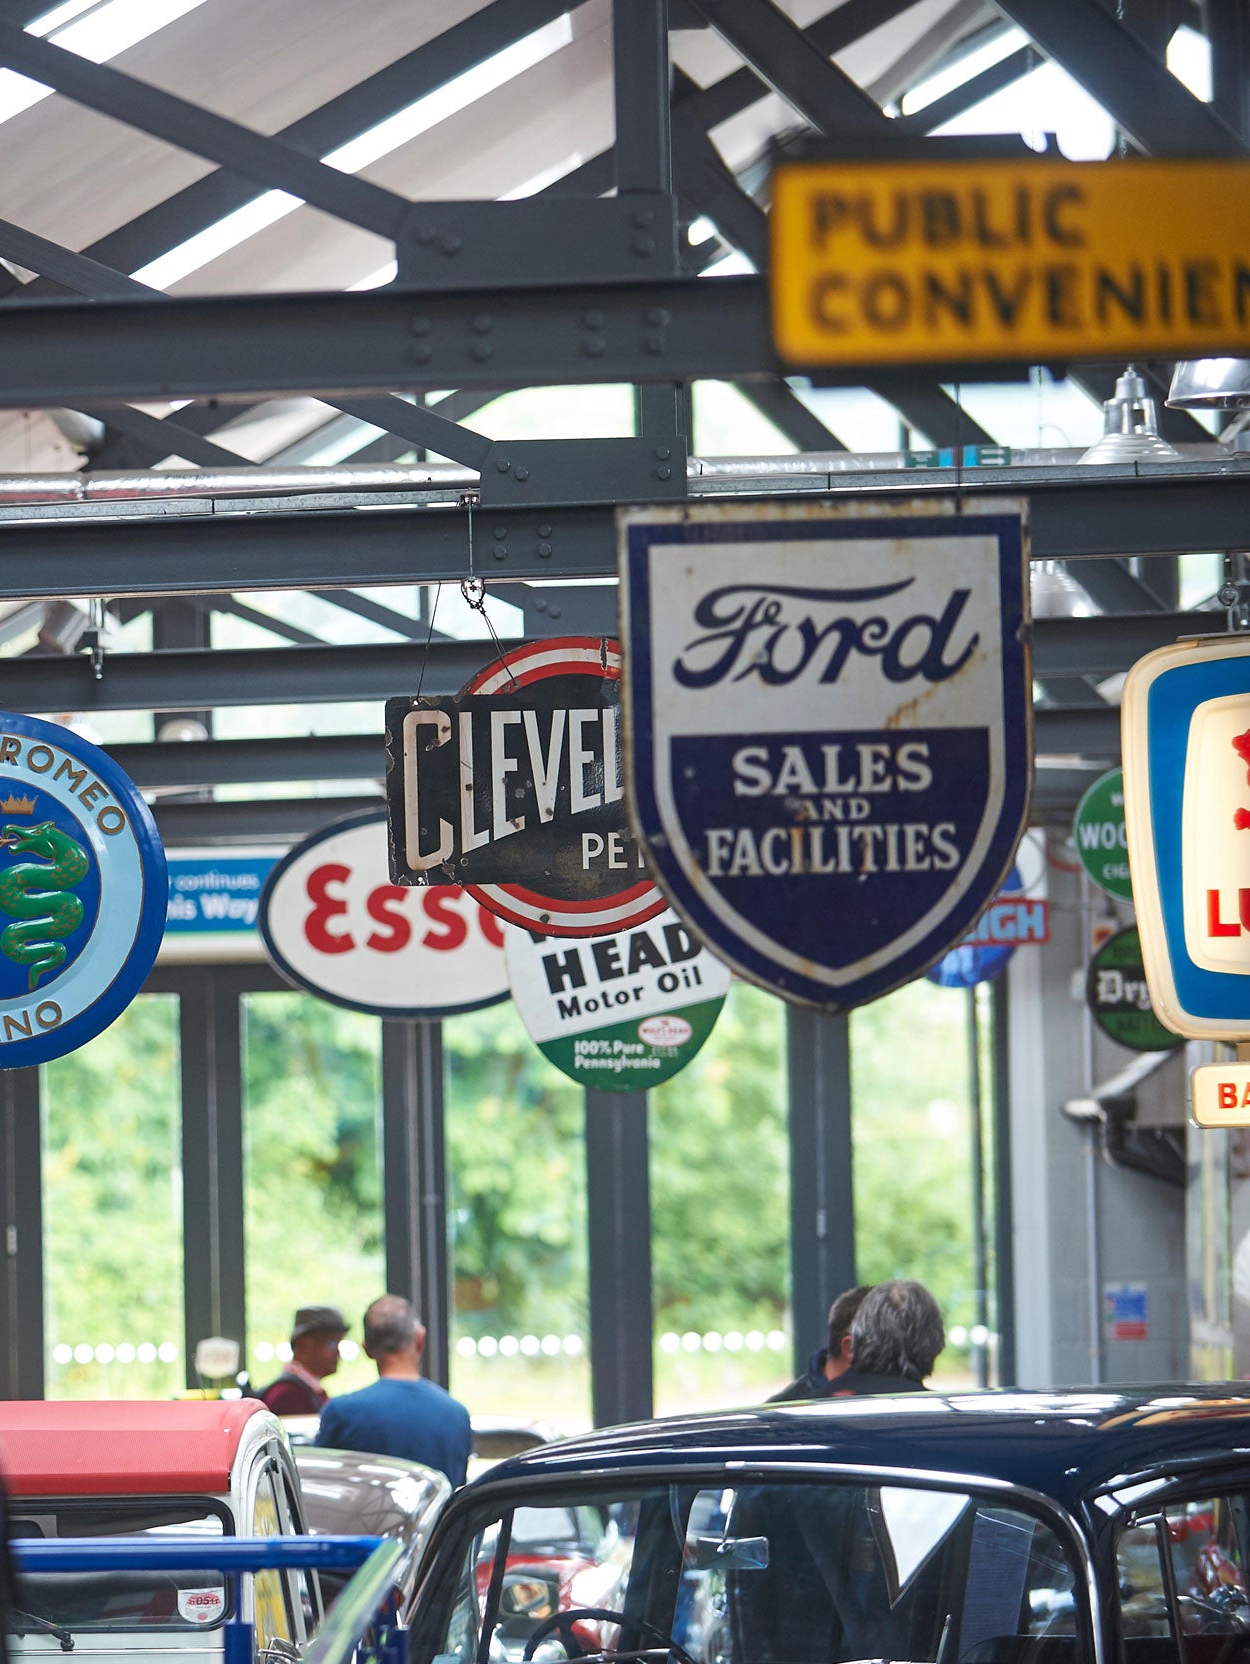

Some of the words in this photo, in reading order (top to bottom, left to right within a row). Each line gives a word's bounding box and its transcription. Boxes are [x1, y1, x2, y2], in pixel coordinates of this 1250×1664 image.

[812, 182, 1088, 255] PUBLIC
[672, 576, 980, 690] Ford
[0, 735, 126, 835] ROMEO
[403, 708, 624, 871] CLEVEL
[731, 742, 934, 797] SALES
[792, 797, 871, 821] AND
[704, 822, 961, 877] FACILITIES
[174, 868, 260, 892] continues
[199, 892, 259, 925] Way
[964, 903, 1045, 942] IGH
[542, 921, 703, 995] HEAD
[556, 984, 645, 1020] Motor
[657, 965, 703, 993] Oil
[574, 1040, 612, 1055] 100%
[613, 1040, 645, 1055] Pure
[574, 1054, 661, 1073] Pennsylvania
